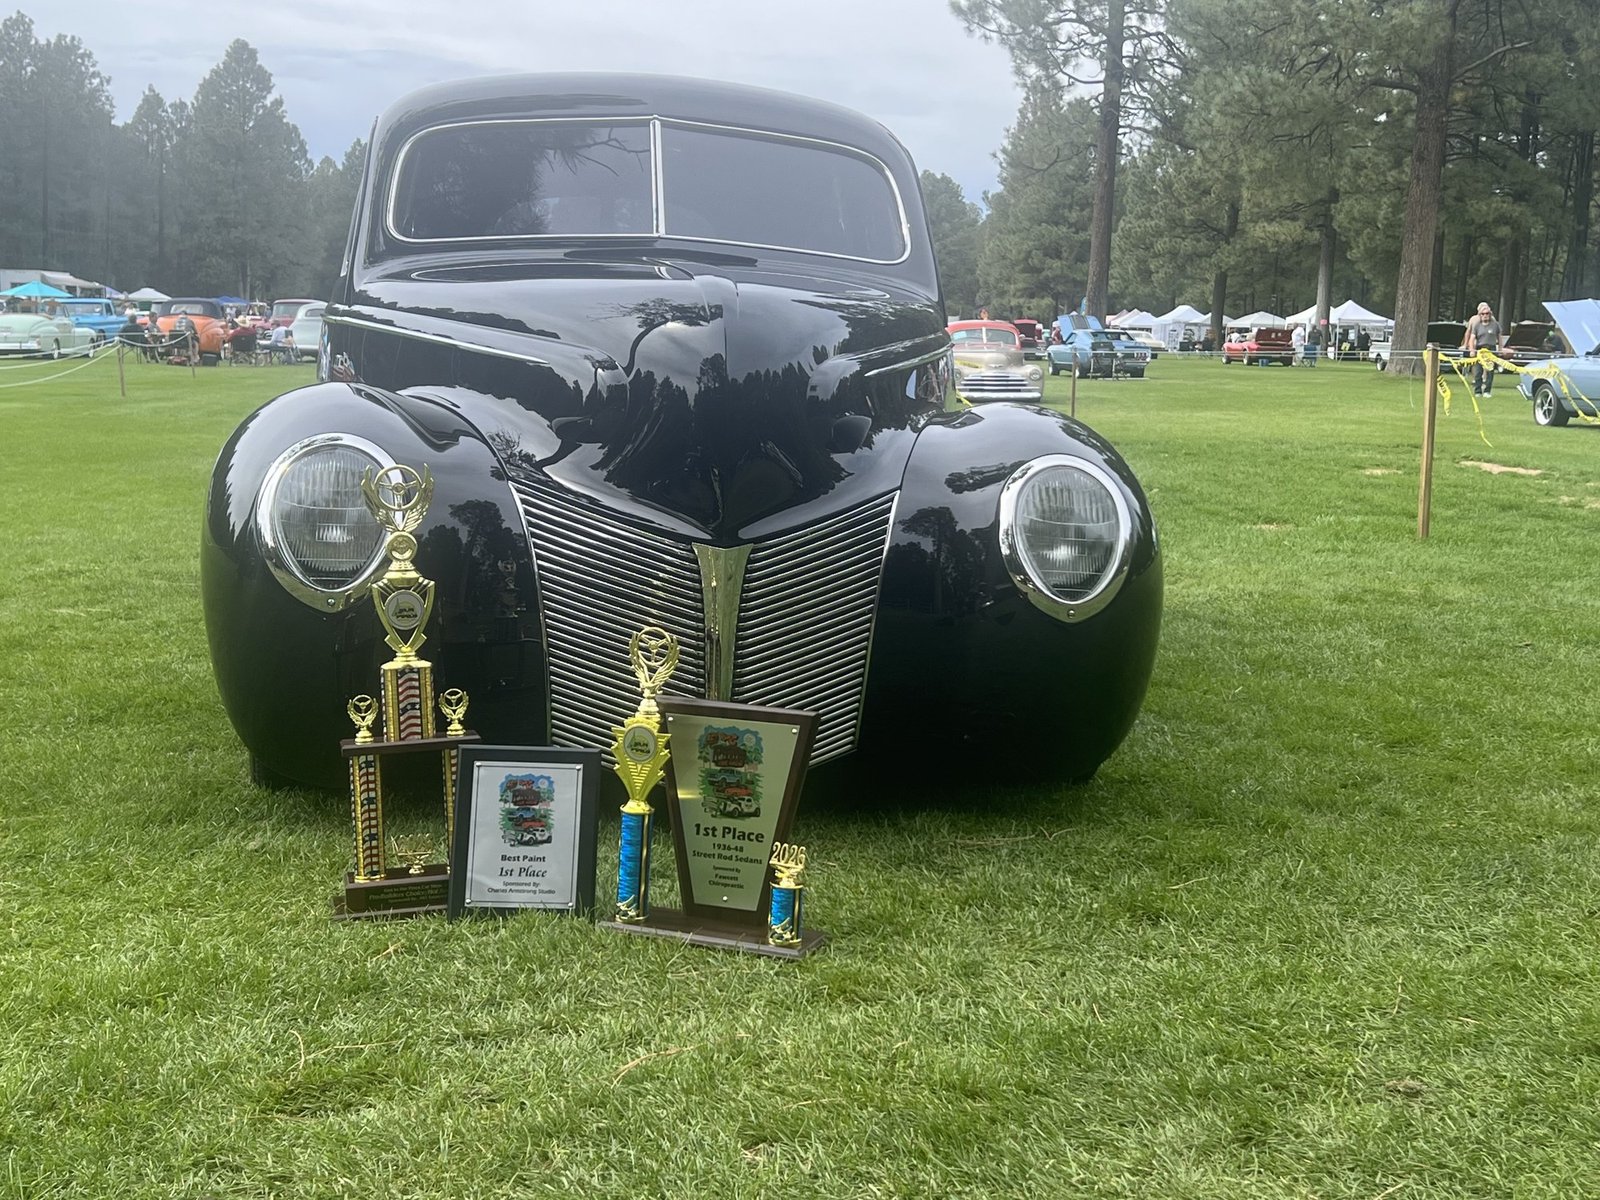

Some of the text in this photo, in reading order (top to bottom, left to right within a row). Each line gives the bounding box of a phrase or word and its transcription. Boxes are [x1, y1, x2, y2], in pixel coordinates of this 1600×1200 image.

[694, 823, 765, 843] 1st Place
[712, 842, 744, 853] 1936-48
[769, 841, 806, 868] 2026
[501, 854, 520, 862] Best
[692, 849, 763, 865] Street Rod Sedans
[498, 865, 548, 878] 1st Place
